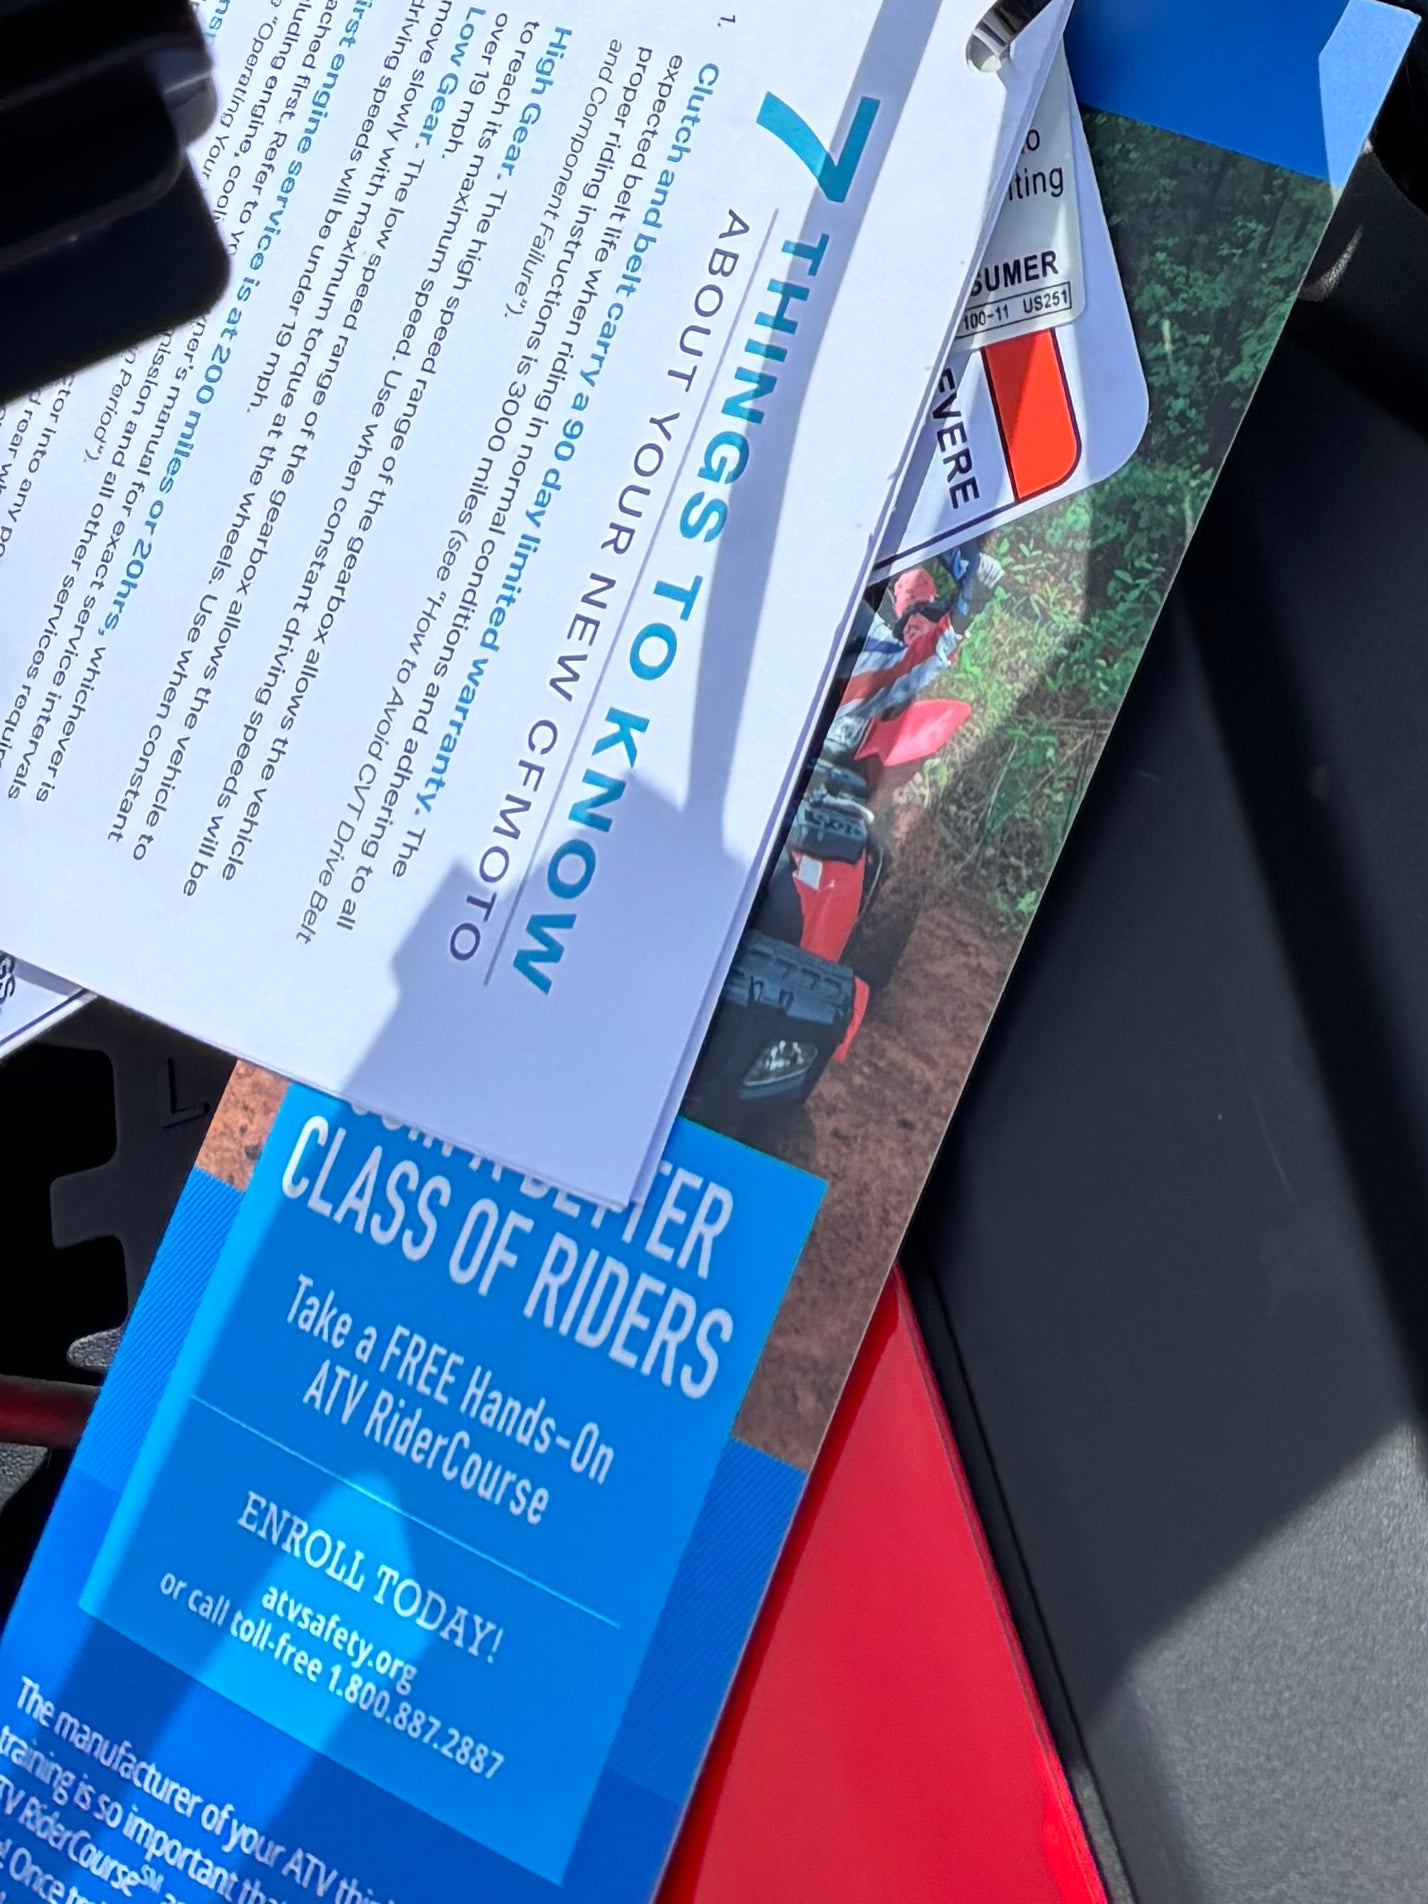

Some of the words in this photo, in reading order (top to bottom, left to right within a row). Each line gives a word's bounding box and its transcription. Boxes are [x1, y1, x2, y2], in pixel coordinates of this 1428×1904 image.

[716, 14, 736, 26] 1.
[530, 26, 572, 95] High
[597, 38, 622, 84] and
[614, 46, 653, 128] proper
[296, 53, 345, 154] engine
[496, 102, 541, 179] Gear.
[630, 54, 682, 170] expected
[666, 62, 719, 163] Clutch
[543, 86, 607, 220] Component
[582, 131, 621, 199] riding
[755, 93, 879, 204] 7
[249, 159, 302, 270] service
[476, 189, 507, 233] The
[608, 173, 643, 222] belt
[641, 168, 675, 229] and
[452, 238, 487, 290] high
[504, 221, 554, 317] Failure”).
[526, 204, 597, 350] instructions
[594, 226, 622, 262] life
[615, 232, 656, 297] belt
[219, 307, 242, 340] at
[236, 276, 260, 301] is
[565, 269, 602, 335] when
[666, 208, 749, 392] ABOUT
[1023, 289, 1068, 314] US251
[420, 295, 460, 374] speed
[516, 354, 538, 376] is
[579, 302, 623, 387] carry
[195, 343, 231, 404] 200
[533, 340, 574, 411] riding
[570, 391, 589, 411] a
[678, 233, 822, 542] THINGS
[390, 378, 427, 451] range
[487, 380, 526, 452] 3000
[525, 416, 549, 438] in
[553, 418, 584, 462] 90
[158, 410, 201, 494] miles
[377, 455, 395, 486] of
[488, 443, 533, 535] normal
[599, 412, 679, 555] YOUR
[144, 499, 164, 535] or
[358, 488, 386, 531] the
[457, 457, 493, 525] miles
[524, 467, 562, 528] day
[97, 537, 152, 636] 20hrs,
[312, 535, 364, 644] gearbox
[436, 529, 468, 581] (see
[479, 533, 541, 651] limited
[408, 590, 446, 655] “How
[433, 538, 495, 677] conditions
[548, 572, 615, 702] NEW
[628, 576, 700, 681] TO
[279, 648, 319, 731] allows
[396, 658, 417, 684] to
[411, 681, 440, 735] and
[47, 646, 106, 778] whichever
[367, 685, 404, 761] Avoid
[413, 657, 488, 815] warranty.
[35, 781, 55, 802] is
[260, 736, 288, 781] the
[347, 763, 377, 821] CVT
[221, 787, 267, 880] vehicle
[360, 737, 418, 858] adhering
[318, 819, 355, 886] Drive
[392, 828, 426, 877] The
[449, 719, 557, 961] CFMOTO
[511, 708, 648, 998] KNOW
[335, 898, 356, 930] all
[350, 865, 373, 893] to
[295, 889, 328, 944] Belt
[281, 1115, 451, 1261] CLASS
[448, 1198, 534, 1296] OF
[523, 1231, 733, 1398] RIDERS
[287, 1273, 352, 1348] Take
[355, 1326, 377, 1363] a
[379, 1324, 464, 1404] FREE
[459, 1365, 613, 1484] Hands-On
[302, 1359, 368, 1424] ATV
[363, 1389, 548, 1524] RiderCourse
[237, 1491, 364, 1591] ENROLL
[373, 1564, 503, 1662] TODAY!
[160, 1573, 186, 1599] or
[188, 1589, 230, 1625] call
[230, 1610, 322, 1681] toll-free
[328, 1664, 504, 1778] 1.800.887.2887
[261, 1586, 416, 1695] atvsafety.org
[0, 1724, 76, 1805] training
[72, 1773, 96, 1811] is
[92, 1793, 123, 1828] so
[122, 1803, 238, 1902] important
[16, 1675, 54, 1727] The
[53, 1710, 204, 1818] manufacturer
[200, 1803, 235, 1836] of
[221, 1817, 286, 1866] your
[280, 1847, 338, 1897] ATV
